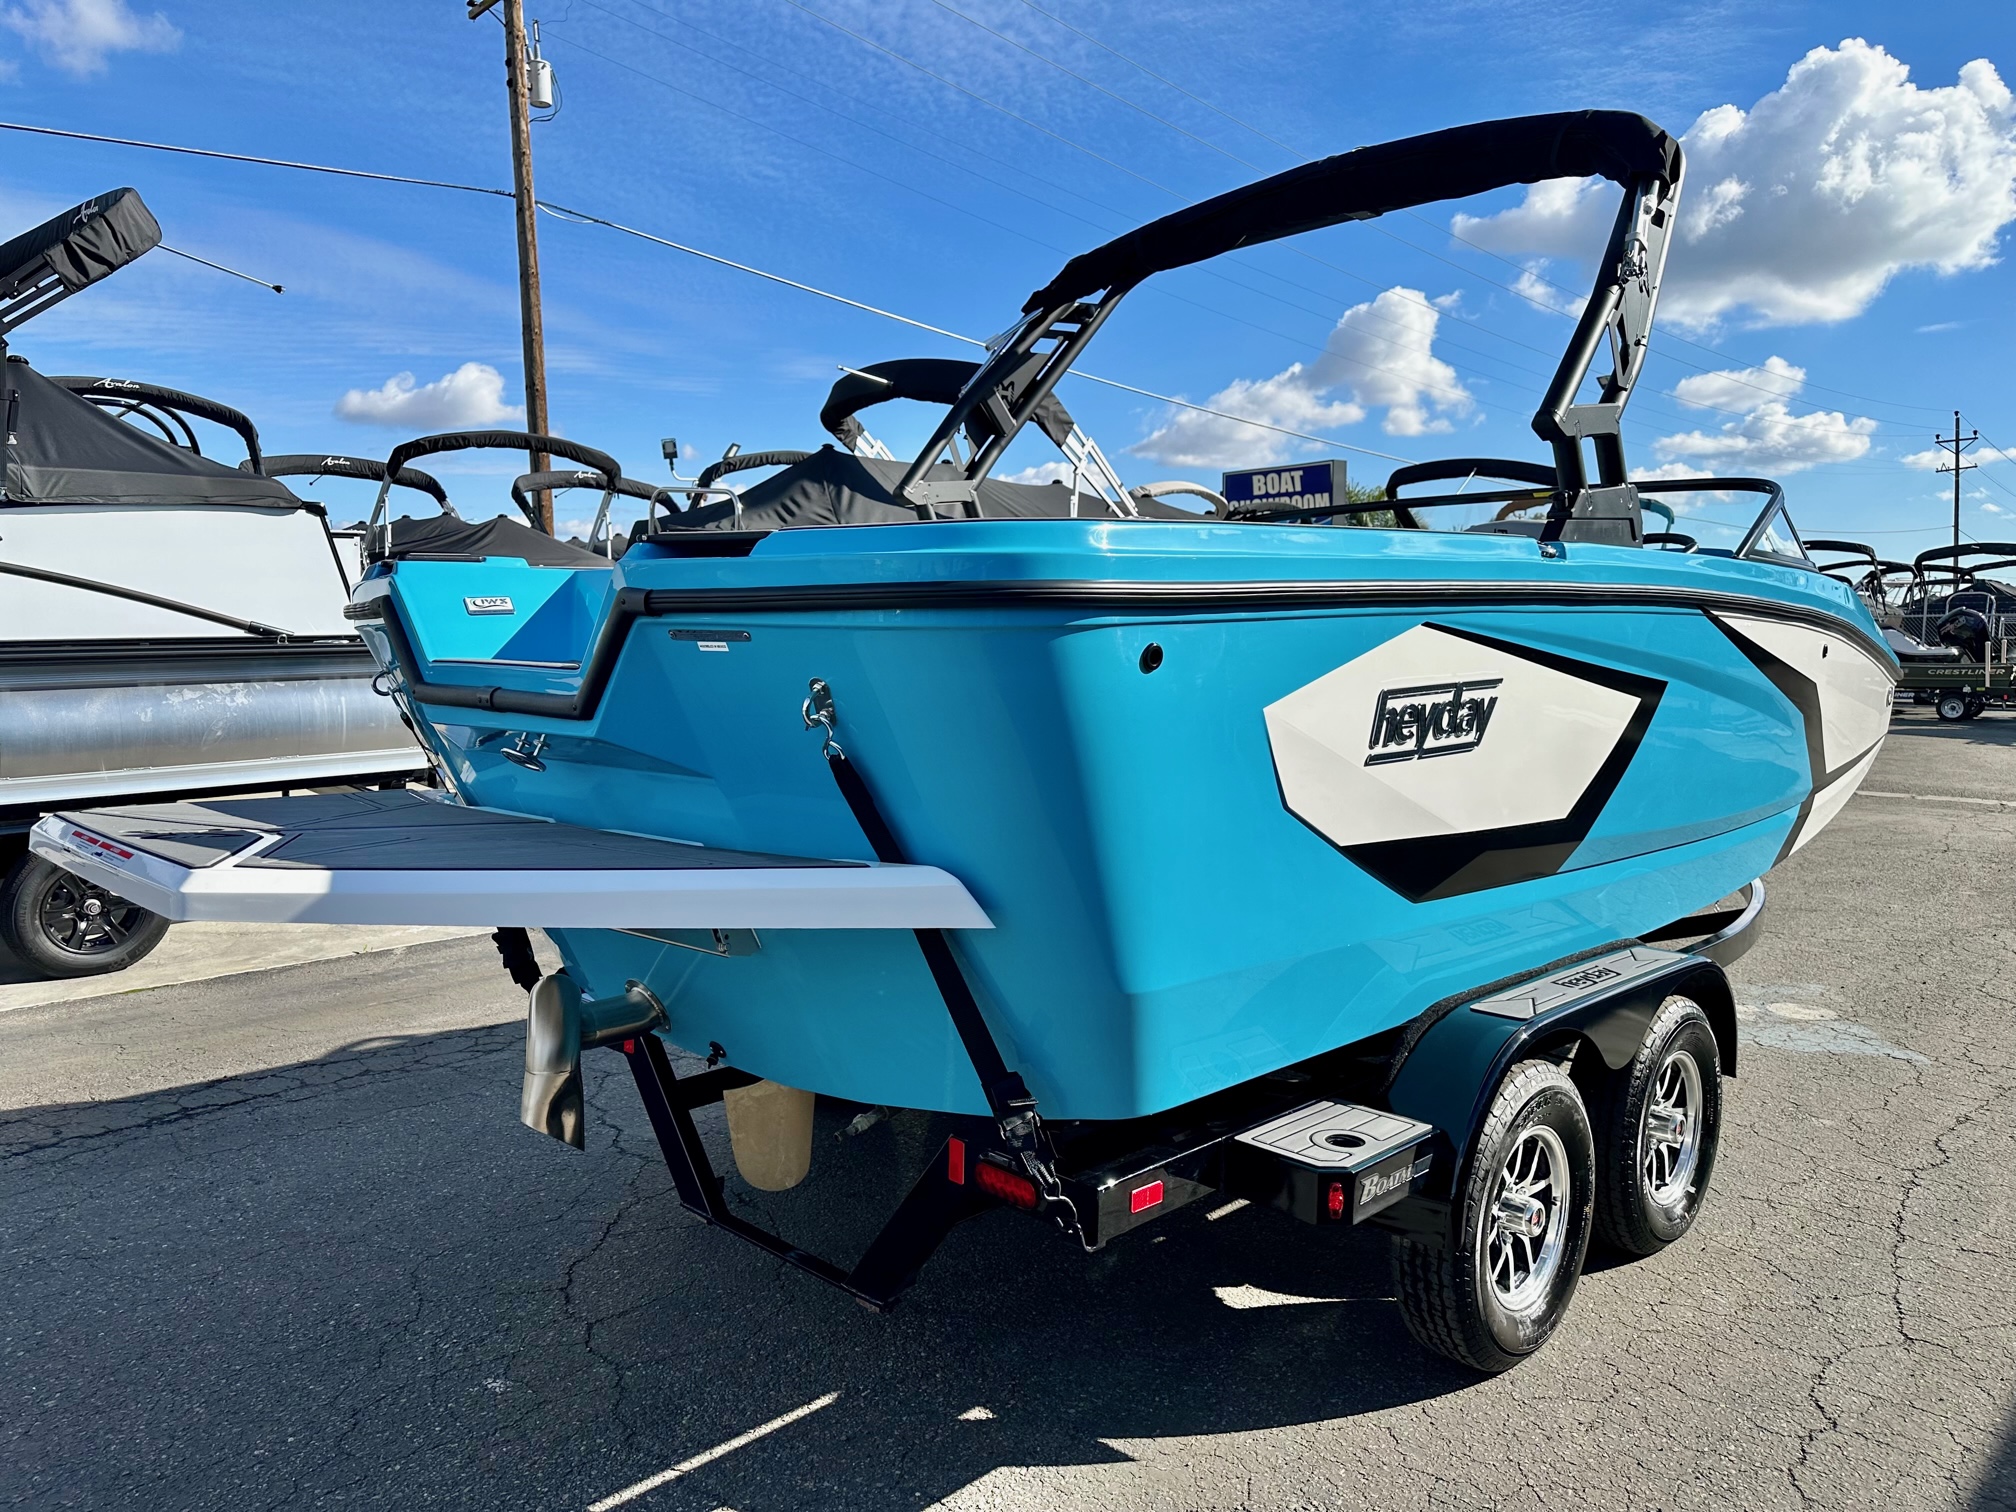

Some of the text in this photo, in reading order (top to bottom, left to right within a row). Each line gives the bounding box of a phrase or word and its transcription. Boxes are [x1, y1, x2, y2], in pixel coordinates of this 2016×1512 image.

[93, 377, 140, 389] Avalon
[1252, 470, 1304, 496] BOAT
[1229, 492, 1331, 512] SOOM
[1927, 668, 2006, 676] CRESTLINER
[1363, 682, 1504, 768] heyday
[1359, 1156, 1430, 1206] BOATM
